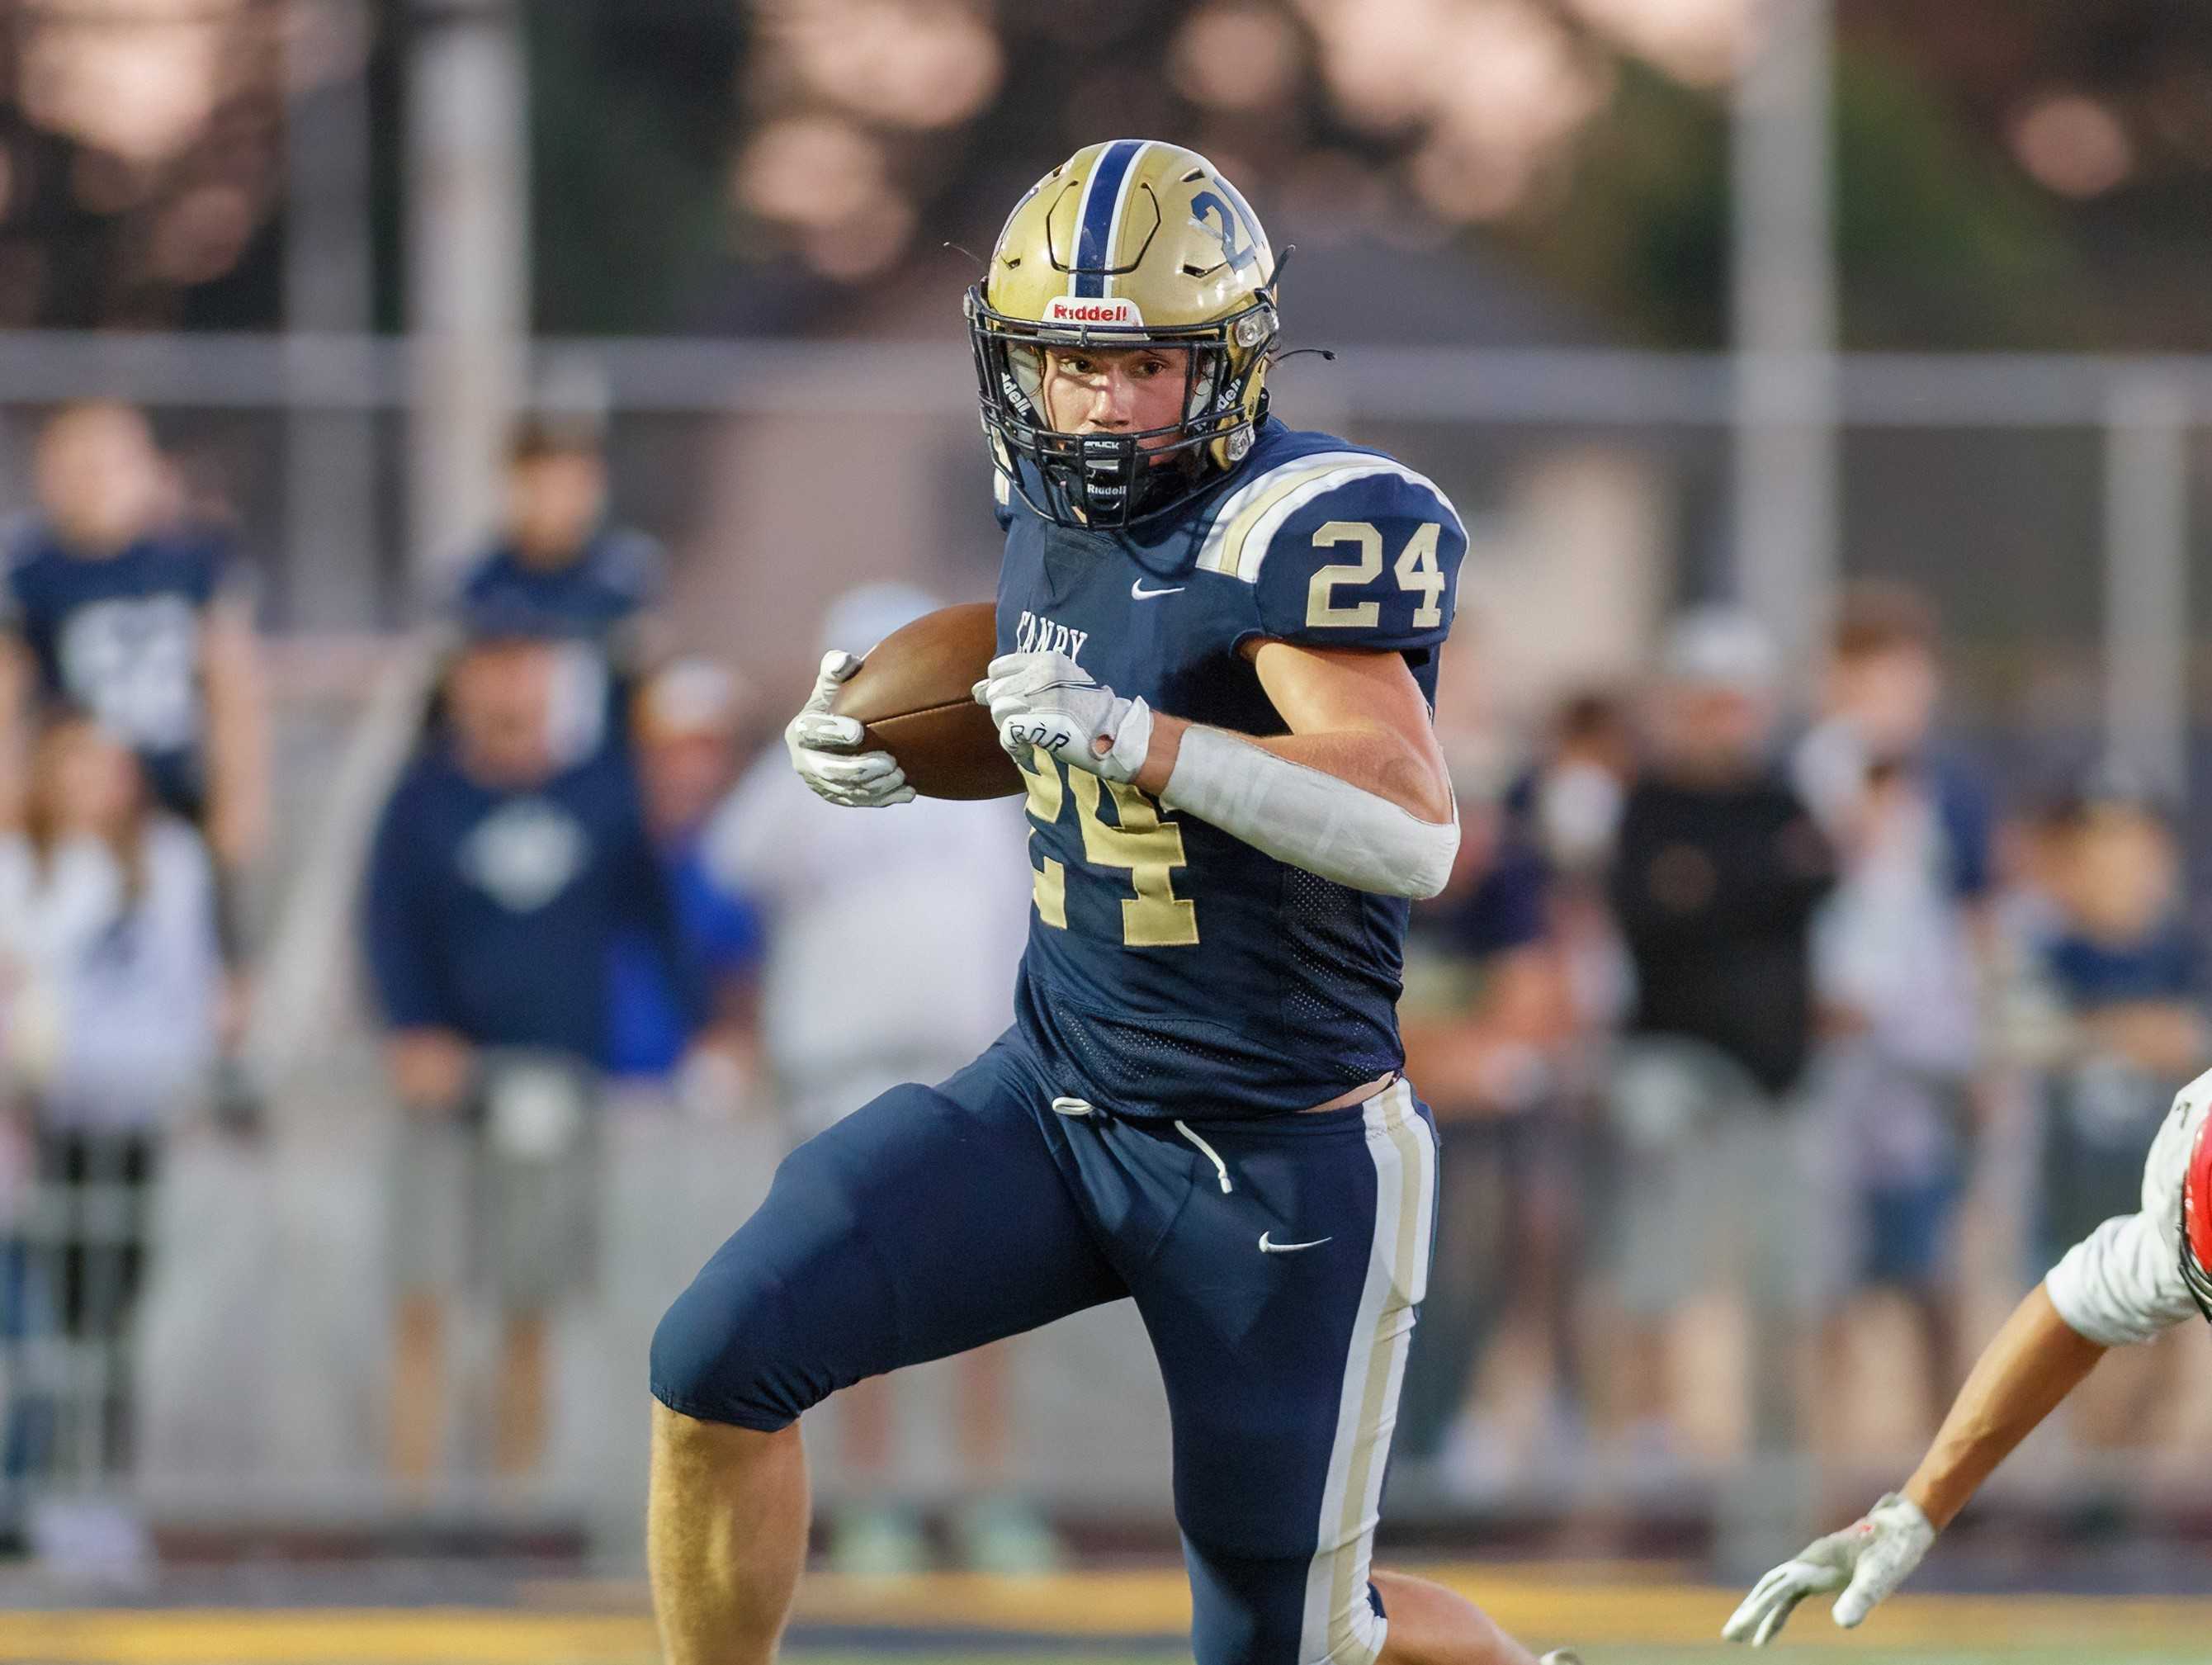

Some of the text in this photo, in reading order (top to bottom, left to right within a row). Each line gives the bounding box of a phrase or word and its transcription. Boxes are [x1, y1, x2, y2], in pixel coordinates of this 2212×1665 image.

[1054, 304, 1127, 321] Riddell
[1306, 521, 1445, 628] 24
[1017, 743, 1200, 946] 24
